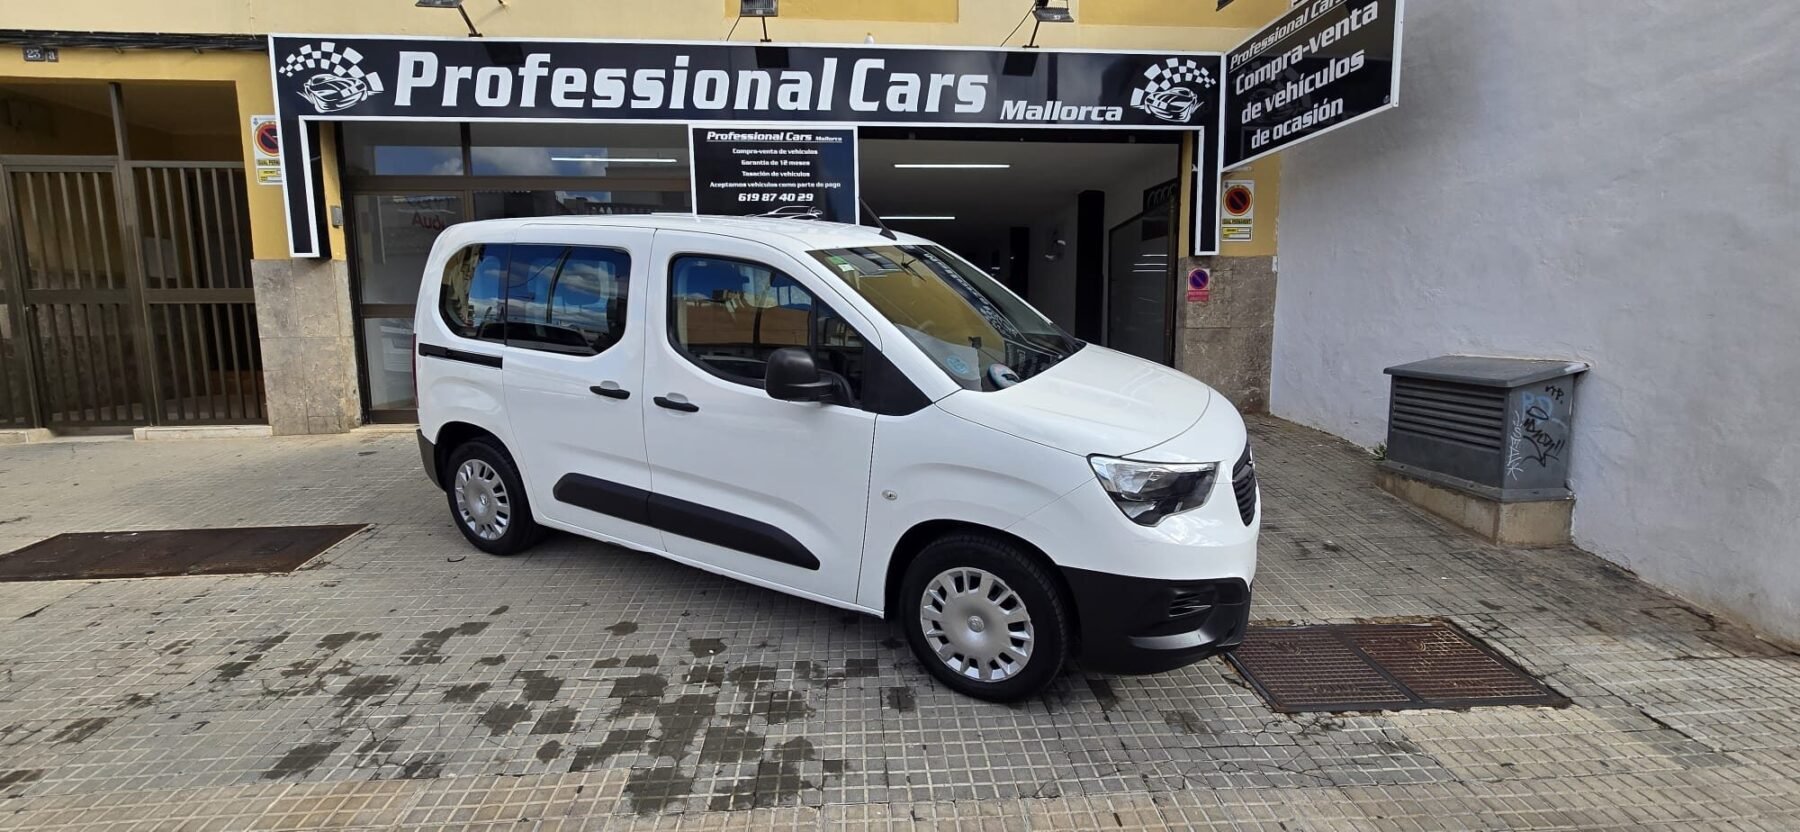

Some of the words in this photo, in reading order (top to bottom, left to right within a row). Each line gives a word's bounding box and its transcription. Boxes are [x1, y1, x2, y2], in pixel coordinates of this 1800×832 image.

[26, 48, 41, 59] 23
[1229, 6, 1310, 70] Professional
[1235, 0, 1378, 96] Compra-venta
[394, 51, 838, 112] Professional
[849, 57, 989, 114] Cars
[1000, 99, 1123, 122] Mallorca
[1241, 101, 1262, 125] de
[1264, 49, 1365, 113] vehículos
[706, 131, 784, 142] Professional
[785, 131, 812, 142] Cars
[1251, 128, 1270, 149] de
[1272, 97, 1344, 141] ocasión
[709, 181, 747, 189] Aceptamos
[738, 193, 760, 202] 619
[761, 193, 777, 202] 87
[778, 193, 795, 202] 40
[797, 193, 814, 202] 29
